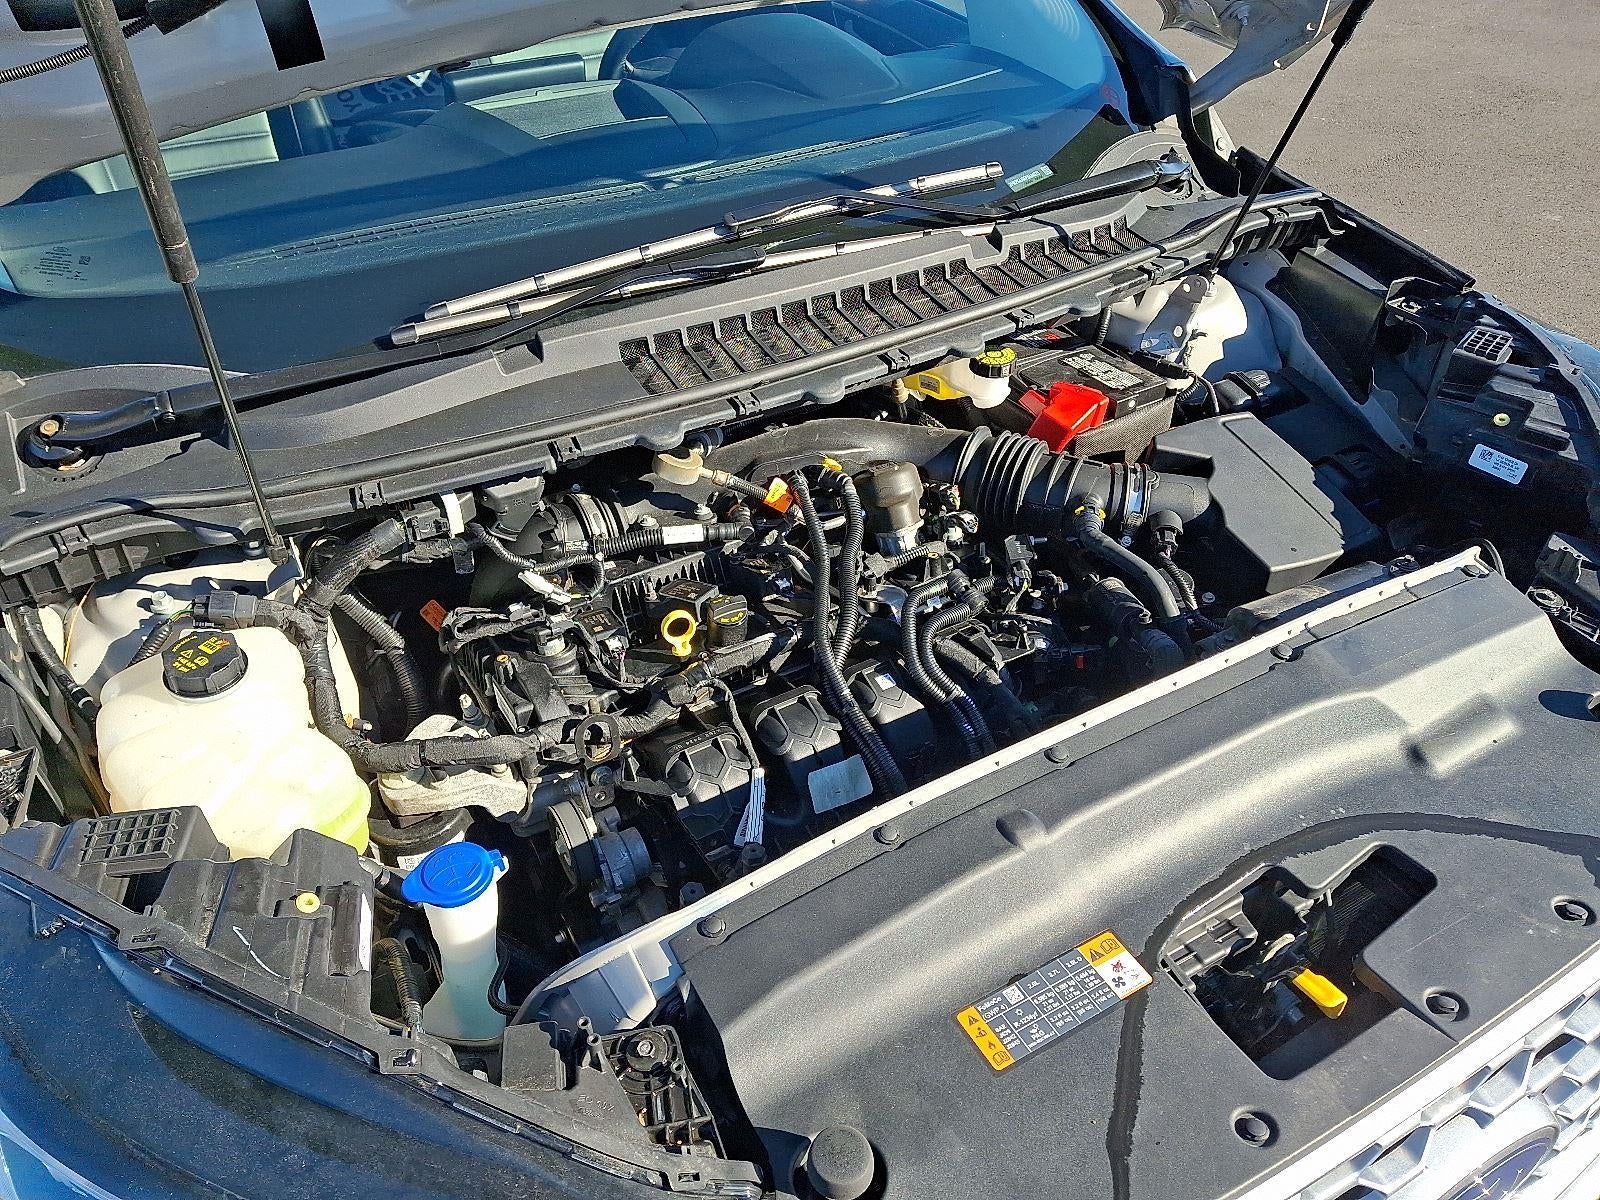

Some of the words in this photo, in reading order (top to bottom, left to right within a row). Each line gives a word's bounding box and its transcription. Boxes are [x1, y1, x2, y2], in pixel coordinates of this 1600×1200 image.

[977, 996, 1002, 1012] FoMoCo
[983, 1006, 1000, 1022] (GWP
[1000, 1003, 1009, 1011] 4)
[1013, 1010, 1038, 1028] R-1234yf
